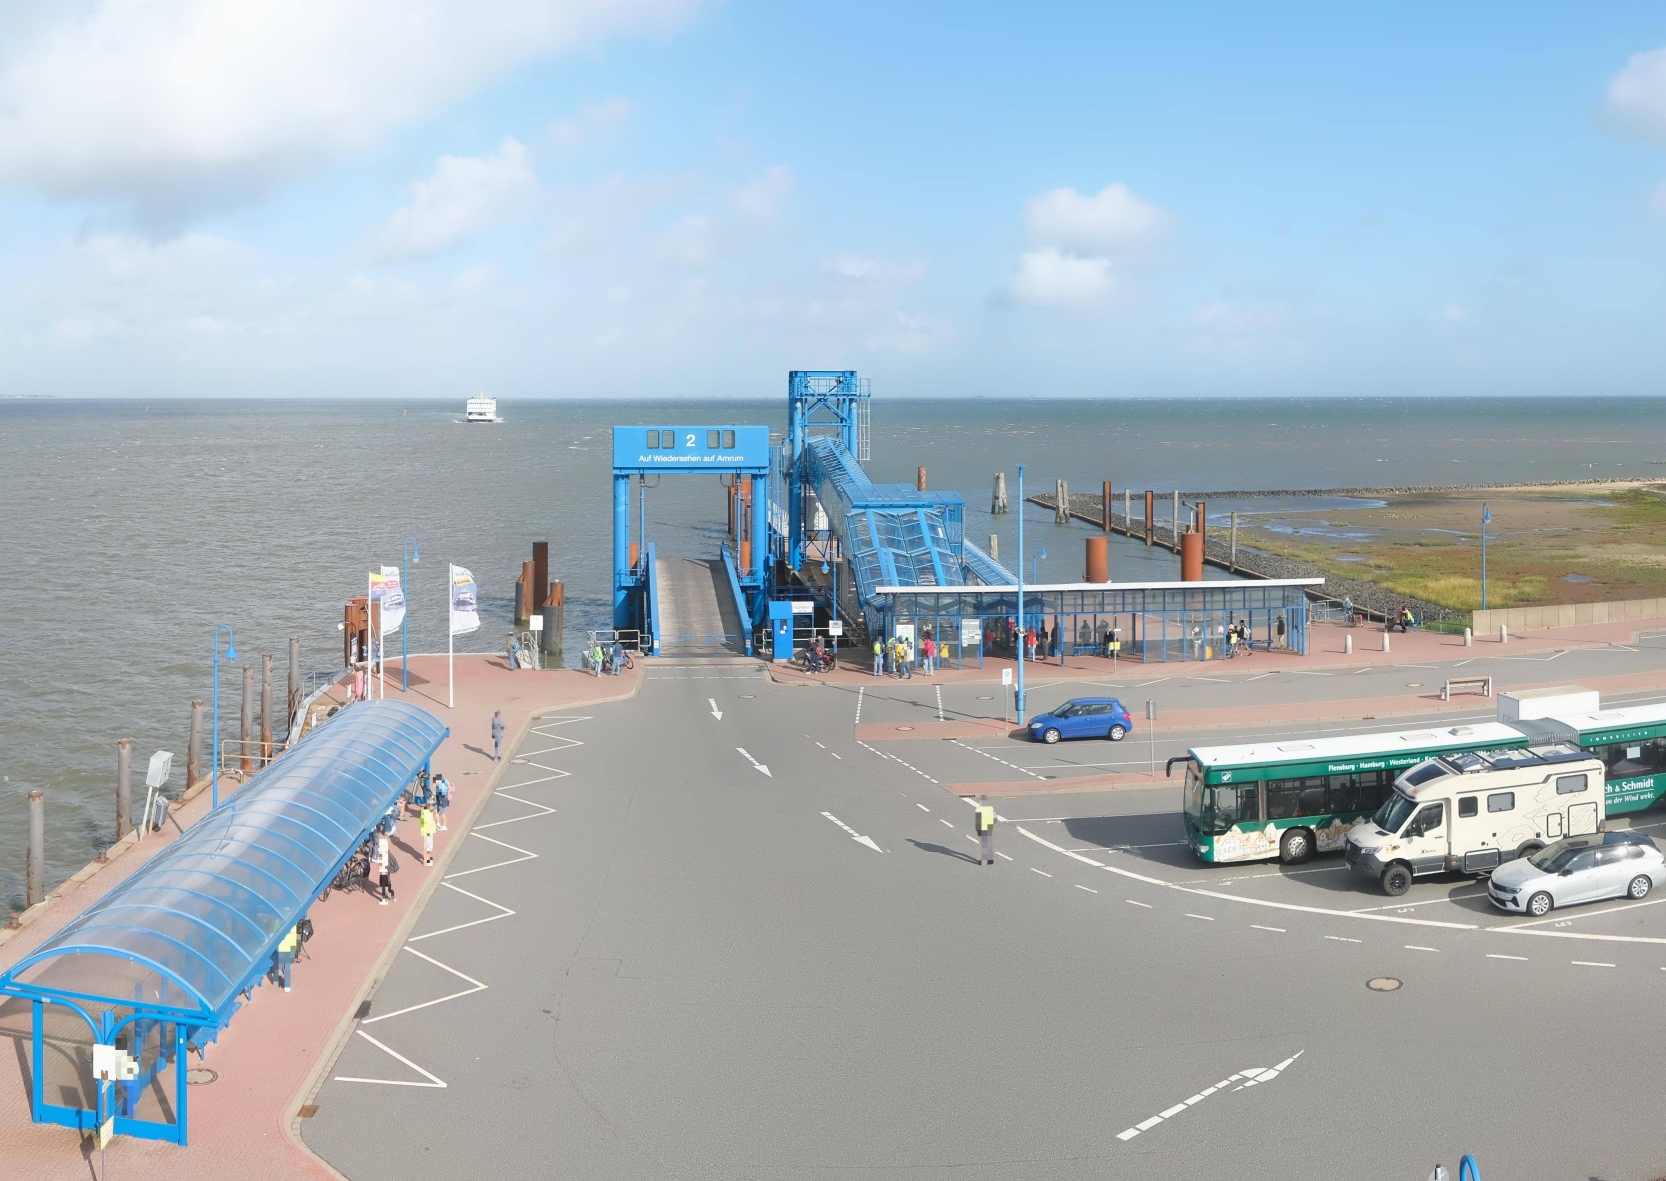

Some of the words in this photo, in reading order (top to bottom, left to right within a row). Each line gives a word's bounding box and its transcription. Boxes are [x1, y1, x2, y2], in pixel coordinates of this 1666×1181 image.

[686, 434, 696, 447] 2
[638, 454, 652, 462] Auf
[653, 454, 701, 462] Wiedersehen
[703, 454, 715, 462] auf
[717, 454, 744, 462] Amrum
[1390, 757, 1420, 765] Westerland
[1622, 778, 1654, 791] Schmidt
[1625, 794, 1639, 802] Wind
